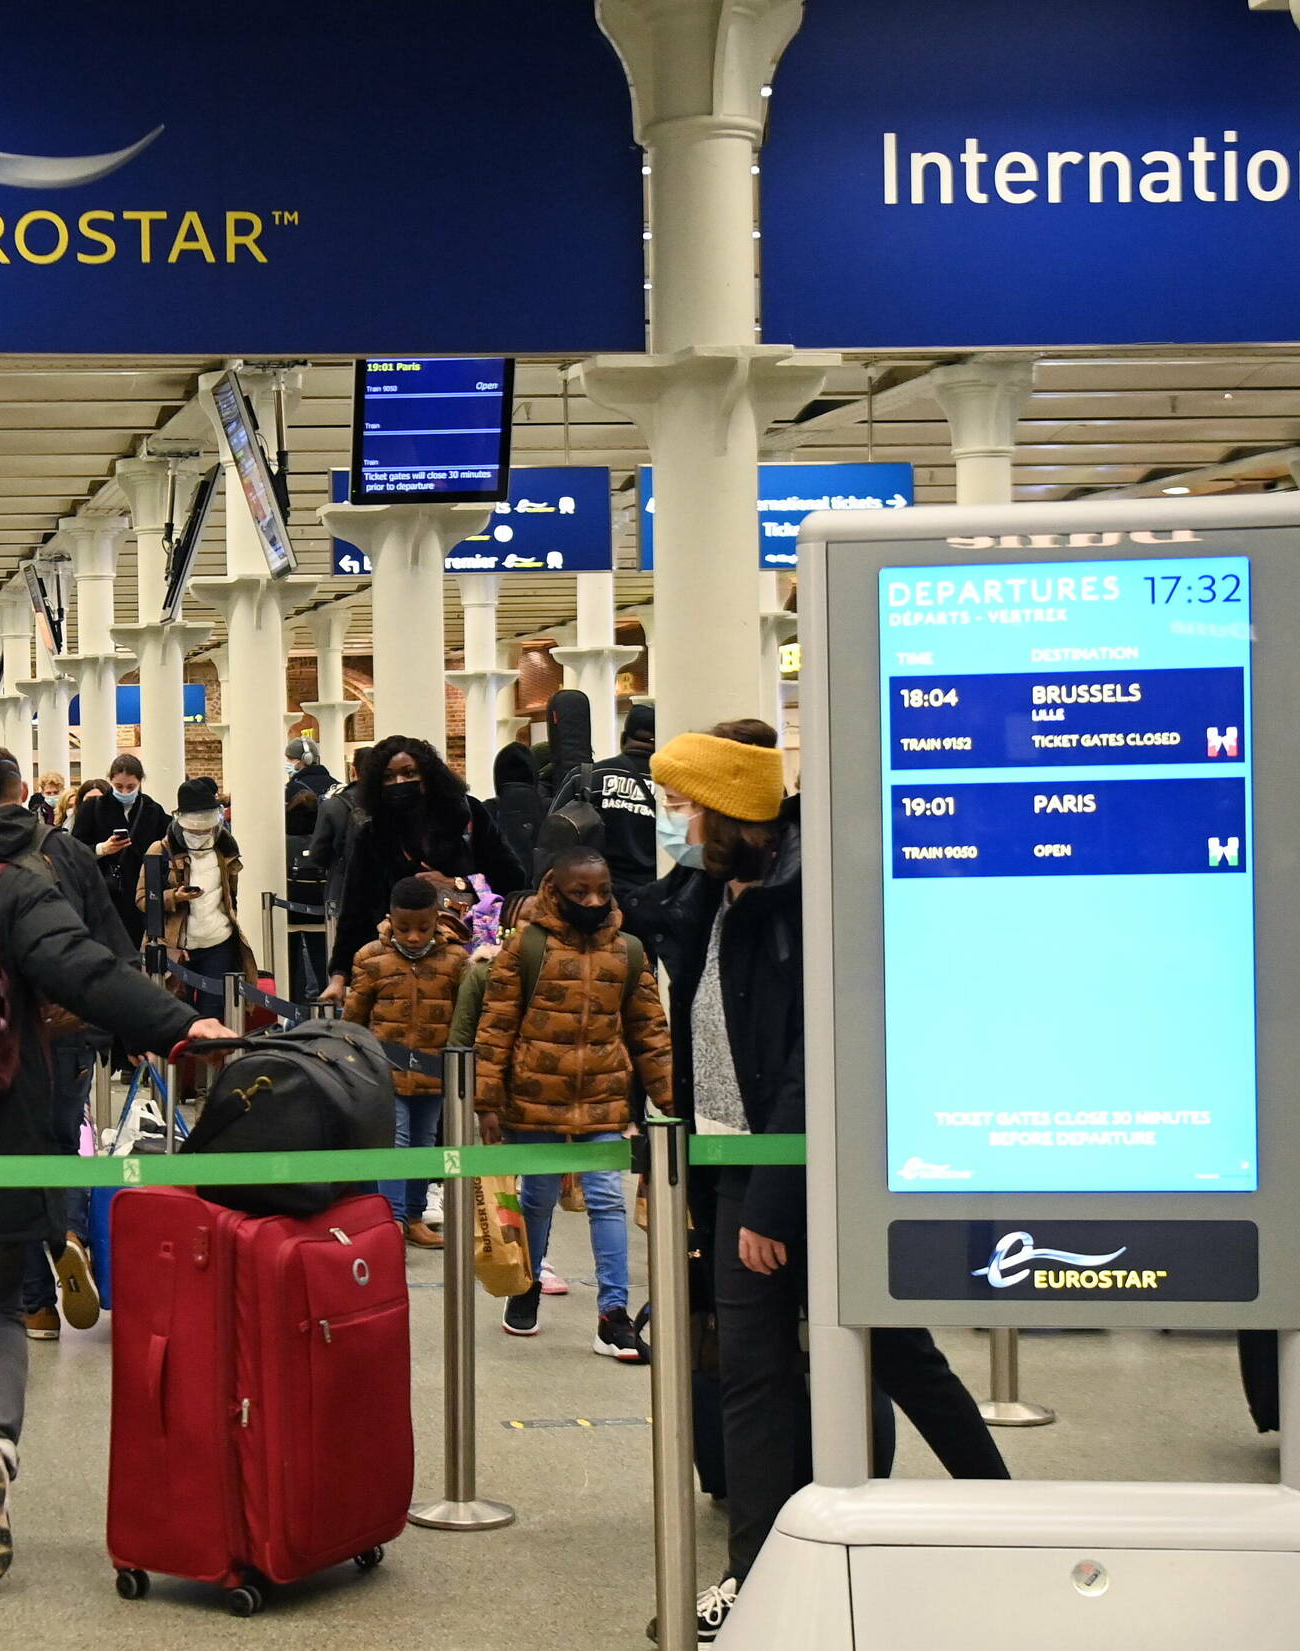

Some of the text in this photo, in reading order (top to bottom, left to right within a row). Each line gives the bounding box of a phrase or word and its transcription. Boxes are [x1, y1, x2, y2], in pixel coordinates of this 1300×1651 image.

[883, 130, 1300, 205] Internatio
[366, 362, 421, 372] 19:01 Paris
[475, 381, 499, 390] Open
[364, 470, 492, 482] Ticket gates will close 30 minutes
[366, 482, 435, 493] prior to departure
[444, 553, 499, 570] remier
[888, 573, 1243, 607] DEPARTURES 17:32
[987, 607, 1069, 625] VERTREK
[894, 645, 1140, 666] TIME DESTINATION
[900, 683, 1143, 708] 18:04 BRUSSELS
[1031, 708, 1066, 722] LILLE
[900, 732, 1182, 752] TRAIN 9152 TICKET GATES CLOSED
[602, 798, 656, 819] BASKETBA
[901, 794, 1097, 817] 19:01 PARIS
[902, 844, 1072, 860] TRAIN 9050 OPEN
[934, 1109, 1211, 1127] TICKET GATES CLOSE 30 MINUTES
[988, 1131, 1157, 1147] BEFORE DEPARTURE
[478, 1208, 492, 1253] BURGER
